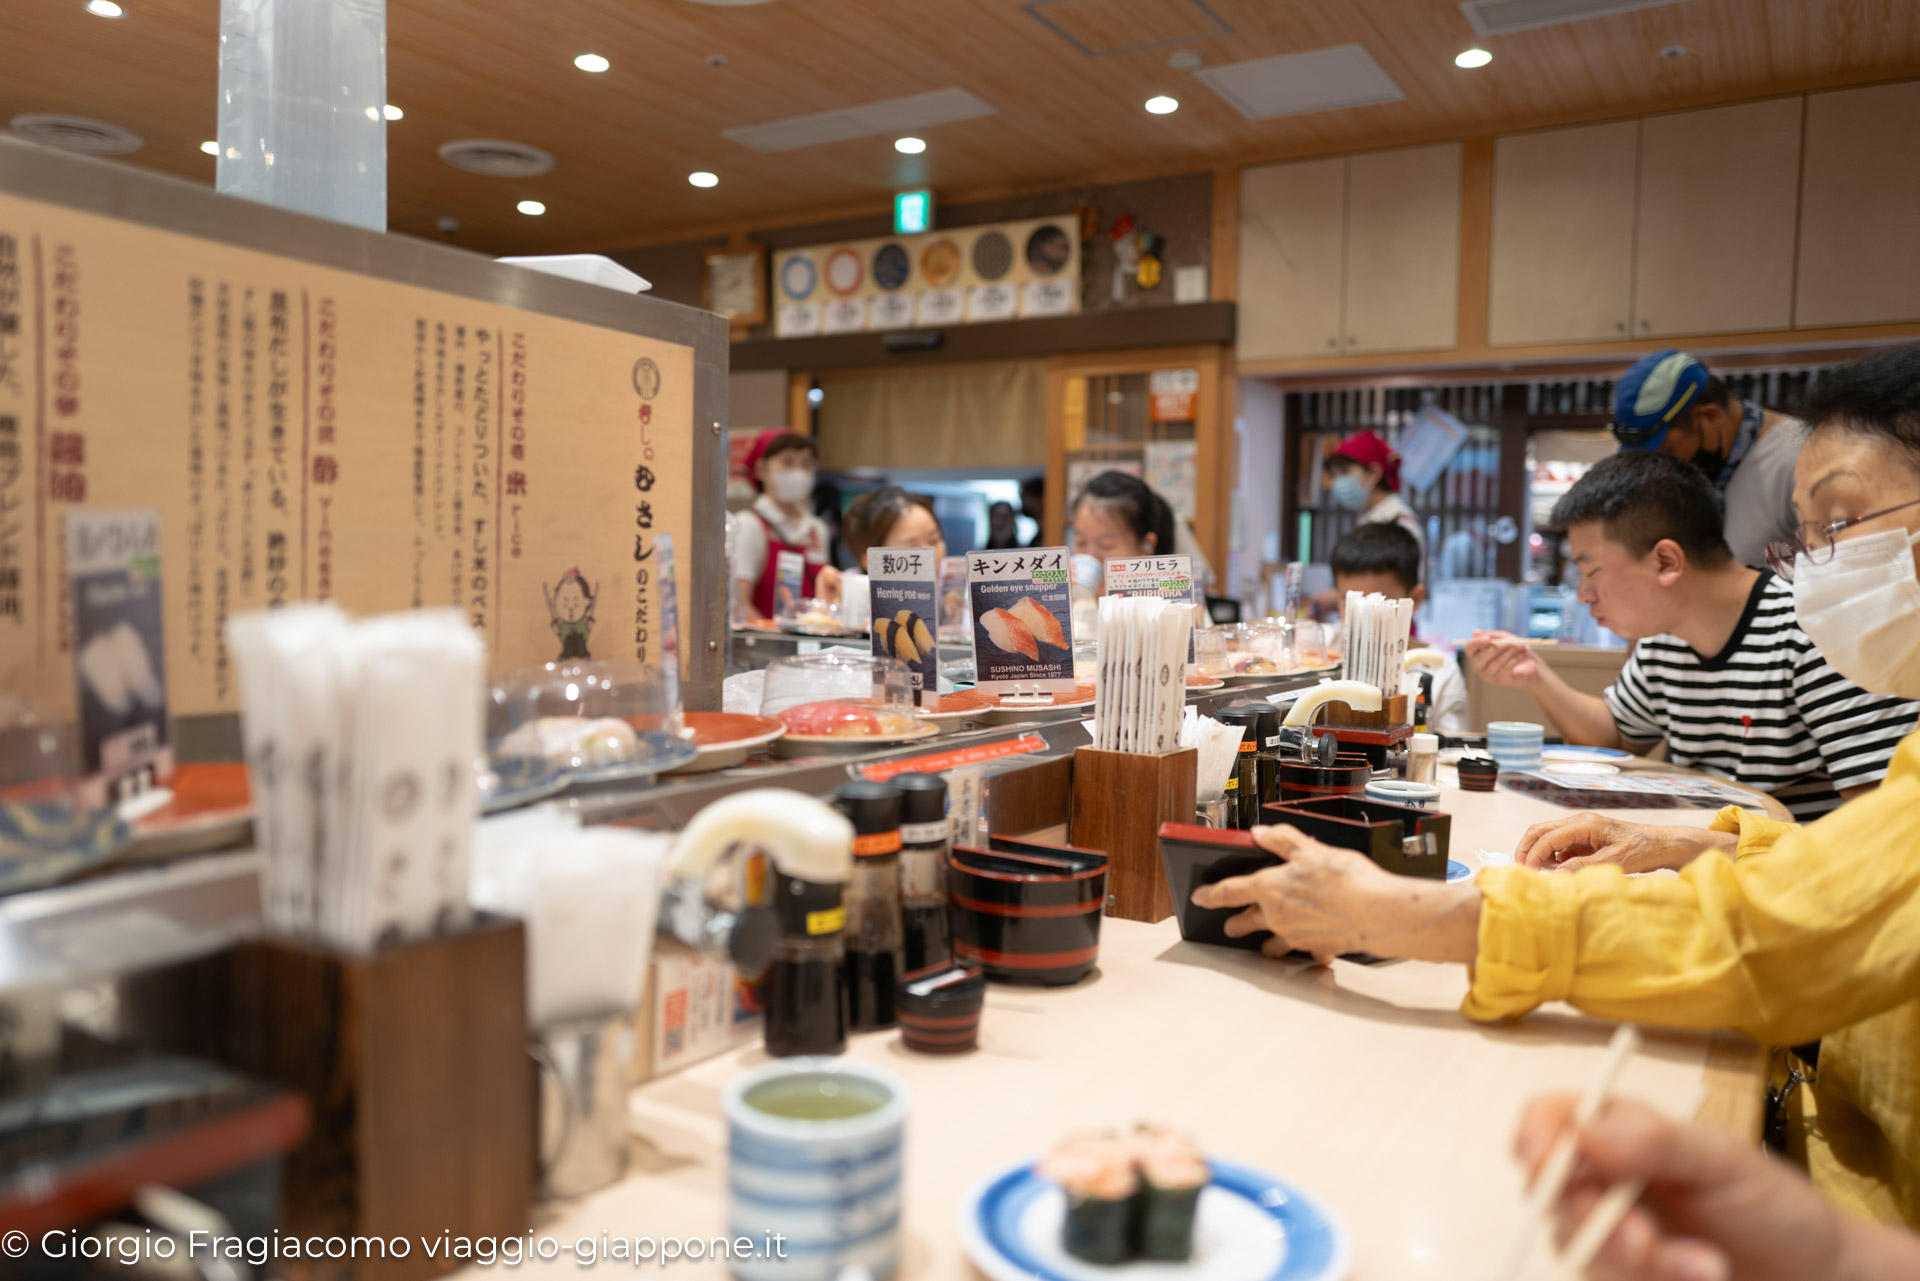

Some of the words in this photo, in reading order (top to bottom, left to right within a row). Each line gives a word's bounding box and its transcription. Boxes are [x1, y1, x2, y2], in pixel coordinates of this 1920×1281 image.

[882, 554, 922, 575] 数の子
[973, 554, 1062, 575] キンメダイ
[1130, 560, 1178, 572] ブリヒラ
[876, 587, 904, 601] Herring
[905, 590, 917, 600] roe
[981, 585, 1009, 593] Golden
[1010, 584, 1024, 593] eye
[1025, 583, 1058, 593] snapper
[990, 665, 1025, 674] SUSHINO
[1026, 663, 1062, 672] MUSASHI
